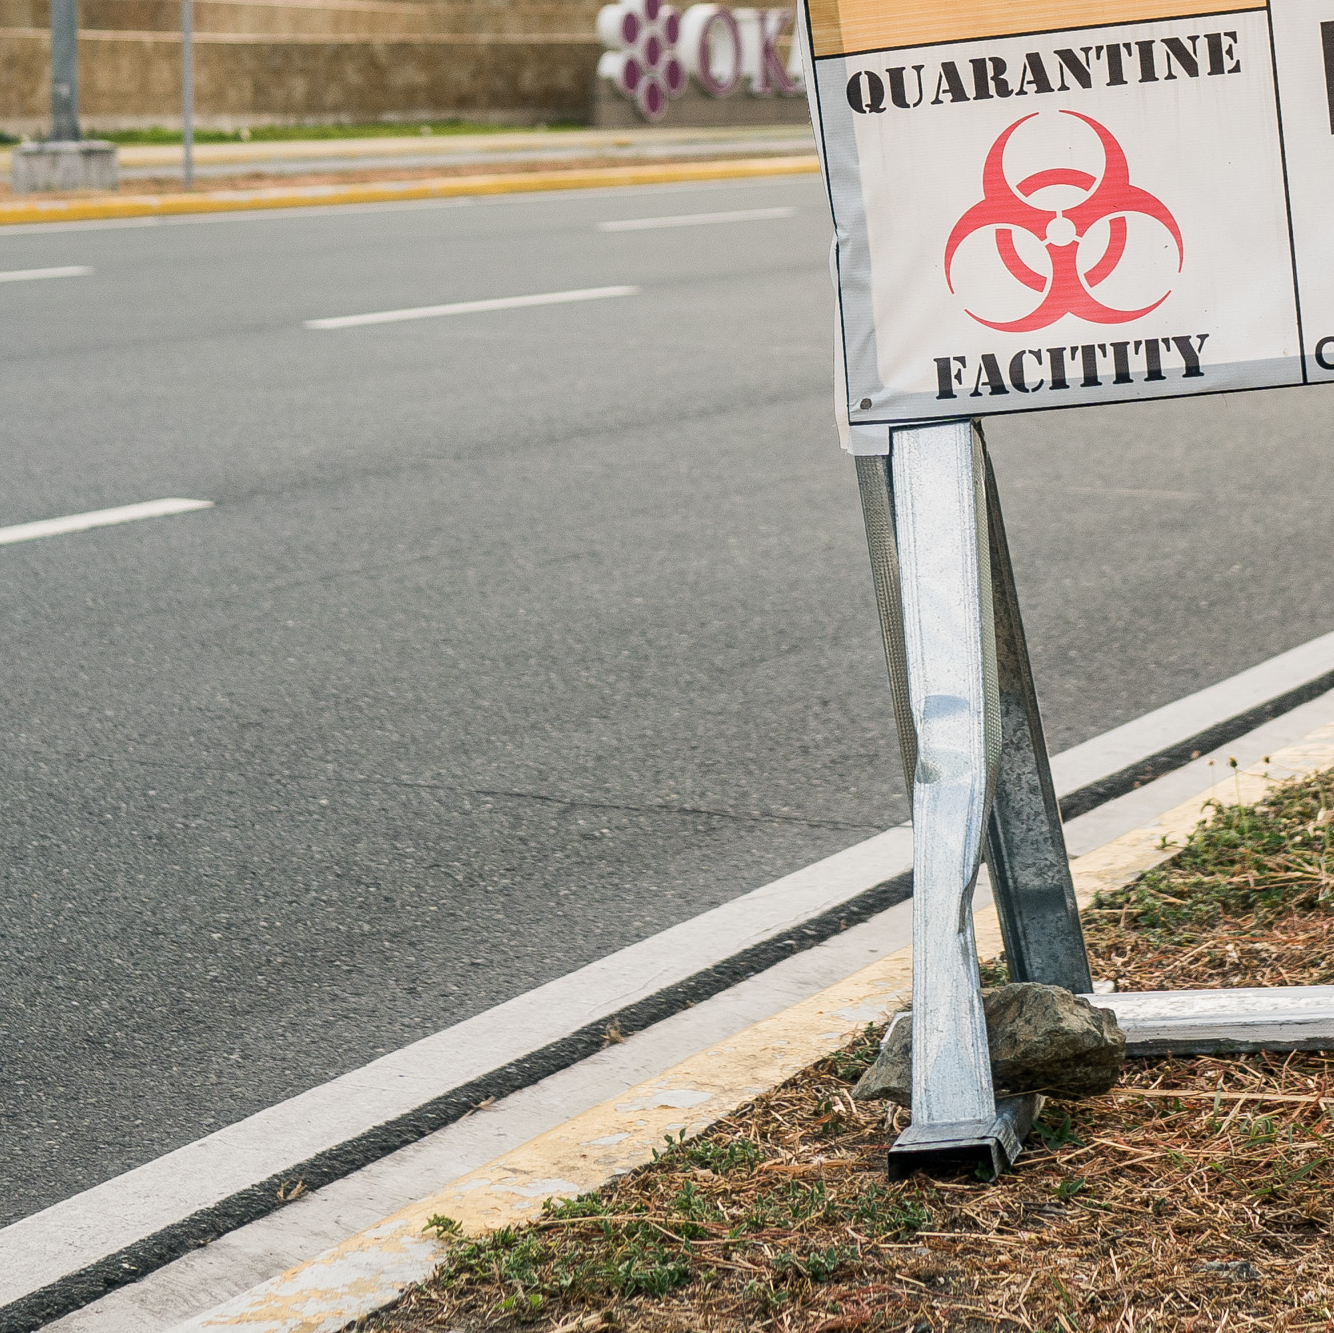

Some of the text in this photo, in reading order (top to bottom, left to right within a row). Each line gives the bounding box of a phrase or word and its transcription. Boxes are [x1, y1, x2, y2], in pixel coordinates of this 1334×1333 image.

[680, 3, 807, 96] OK
[846, 31, 1241, 114] QUARANTINE
[933, 333, 1209, 400] FACITITY
